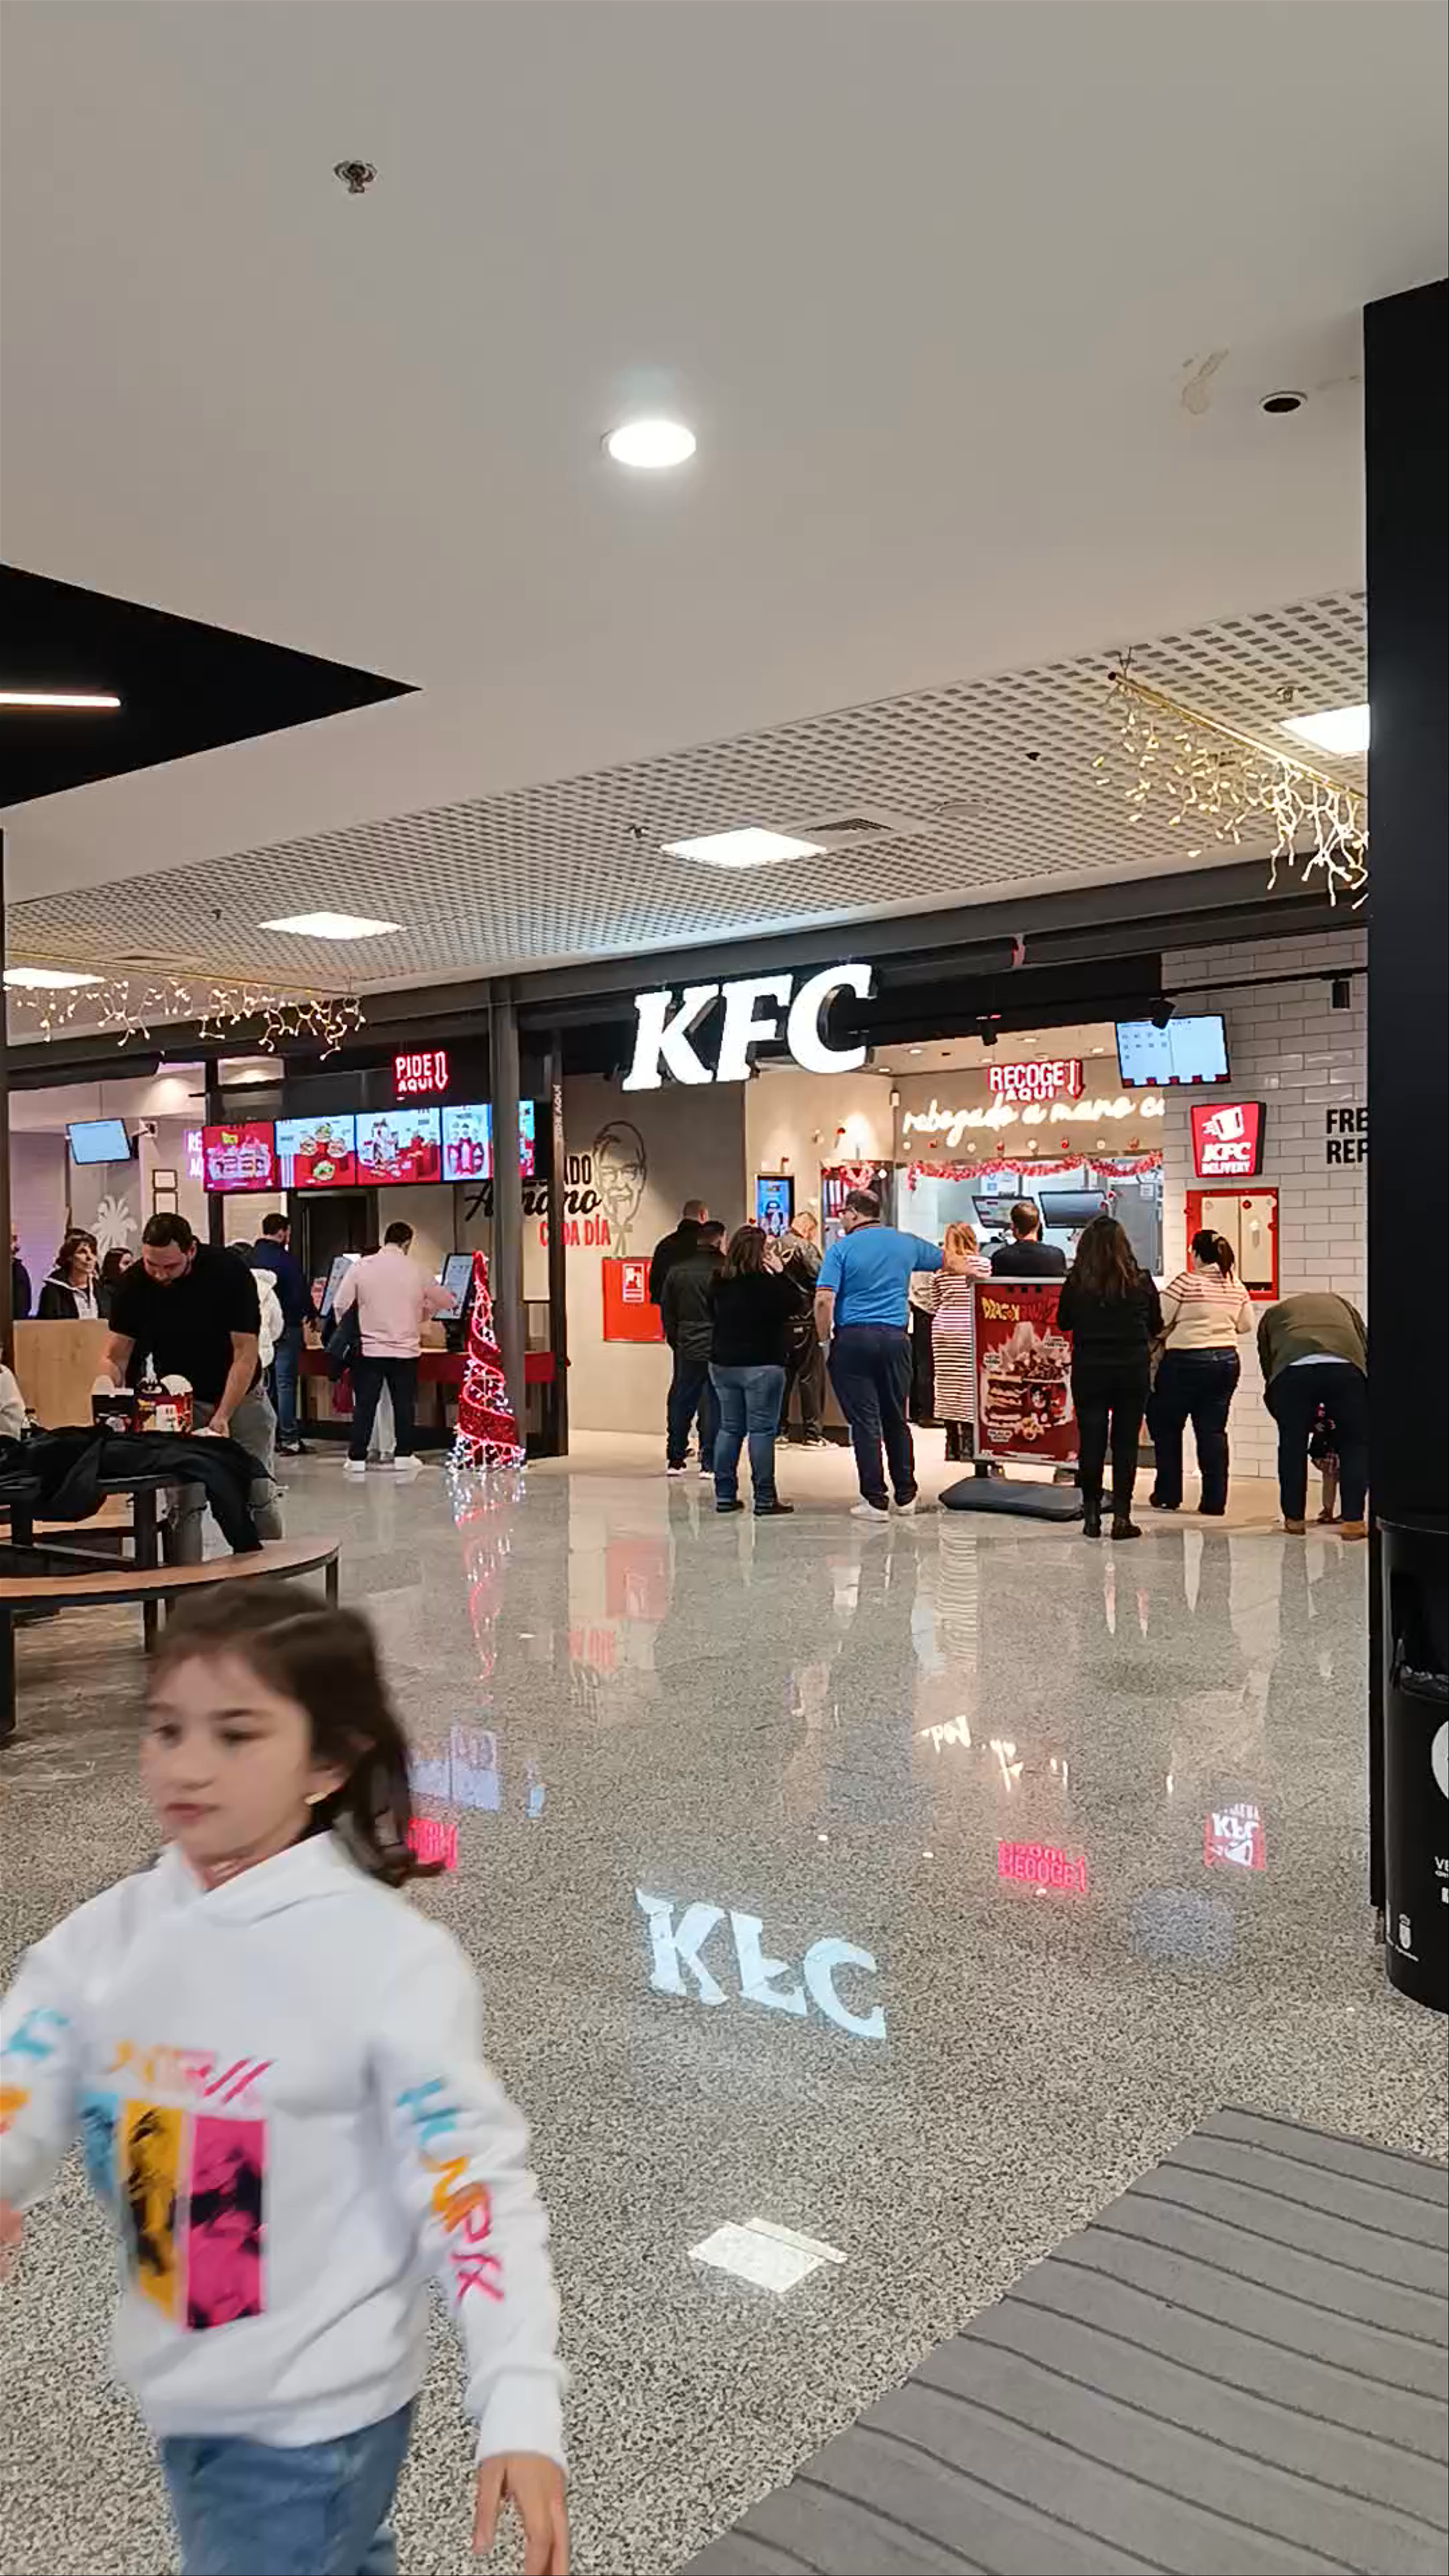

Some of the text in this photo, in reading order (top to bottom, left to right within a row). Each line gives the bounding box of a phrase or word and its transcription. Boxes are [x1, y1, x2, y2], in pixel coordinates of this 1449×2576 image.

[622, 964, 872, 1090] KFC
[395, 1053, 432, 1079] PIDE
[989, 1061, 1065, 1090] RECOGE
[398, 1077, 433, 1092] AQUI
[1005, 1085, 1054, 1103] AQUI
[1022, 1103, 1046, 1124] a
[1050, 1096, 1136, 1123] mano
[1202, 1142, 1251, 1161] KFC
[539, 1213, 611, 1247] CDA DÍA
